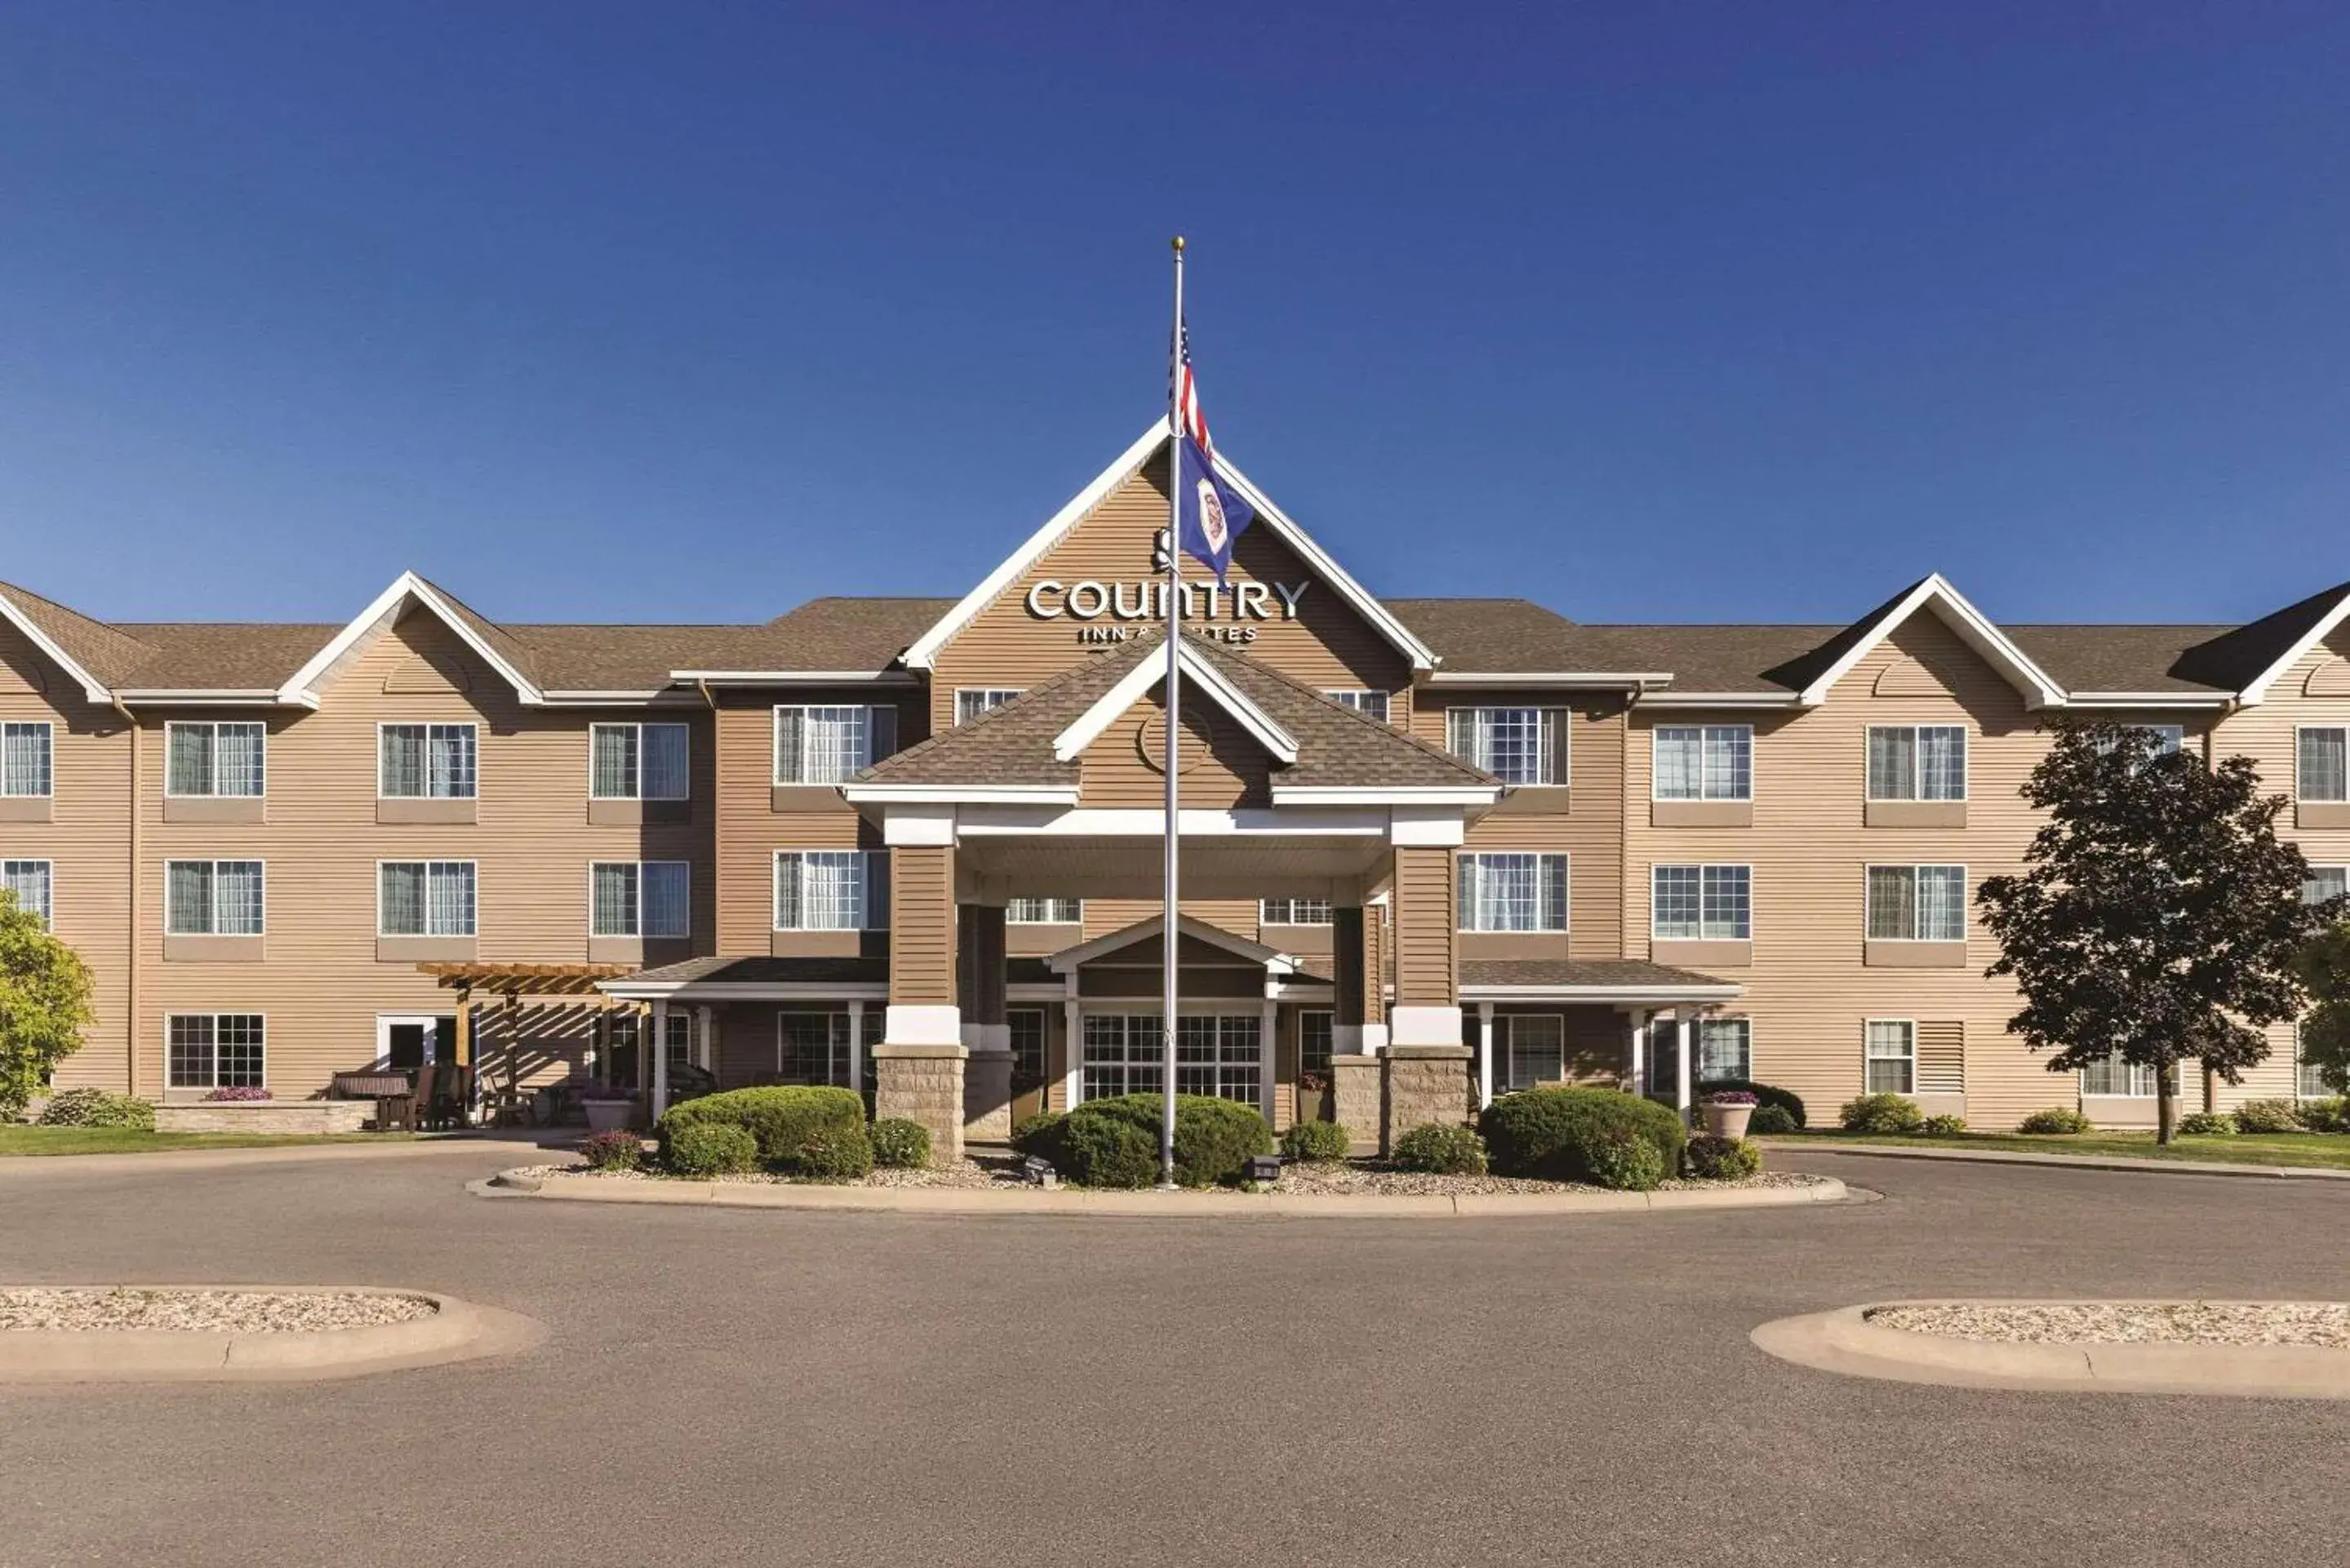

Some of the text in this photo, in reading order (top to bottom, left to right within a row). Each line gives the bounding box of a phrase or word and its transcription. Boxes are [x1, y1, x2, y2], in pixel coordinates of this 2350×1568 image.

[1028, 580, 1310, 618] COUNTRY
[1082, 625, 1126, 640] INN
[1191, 625, 1257, 640] ITES
